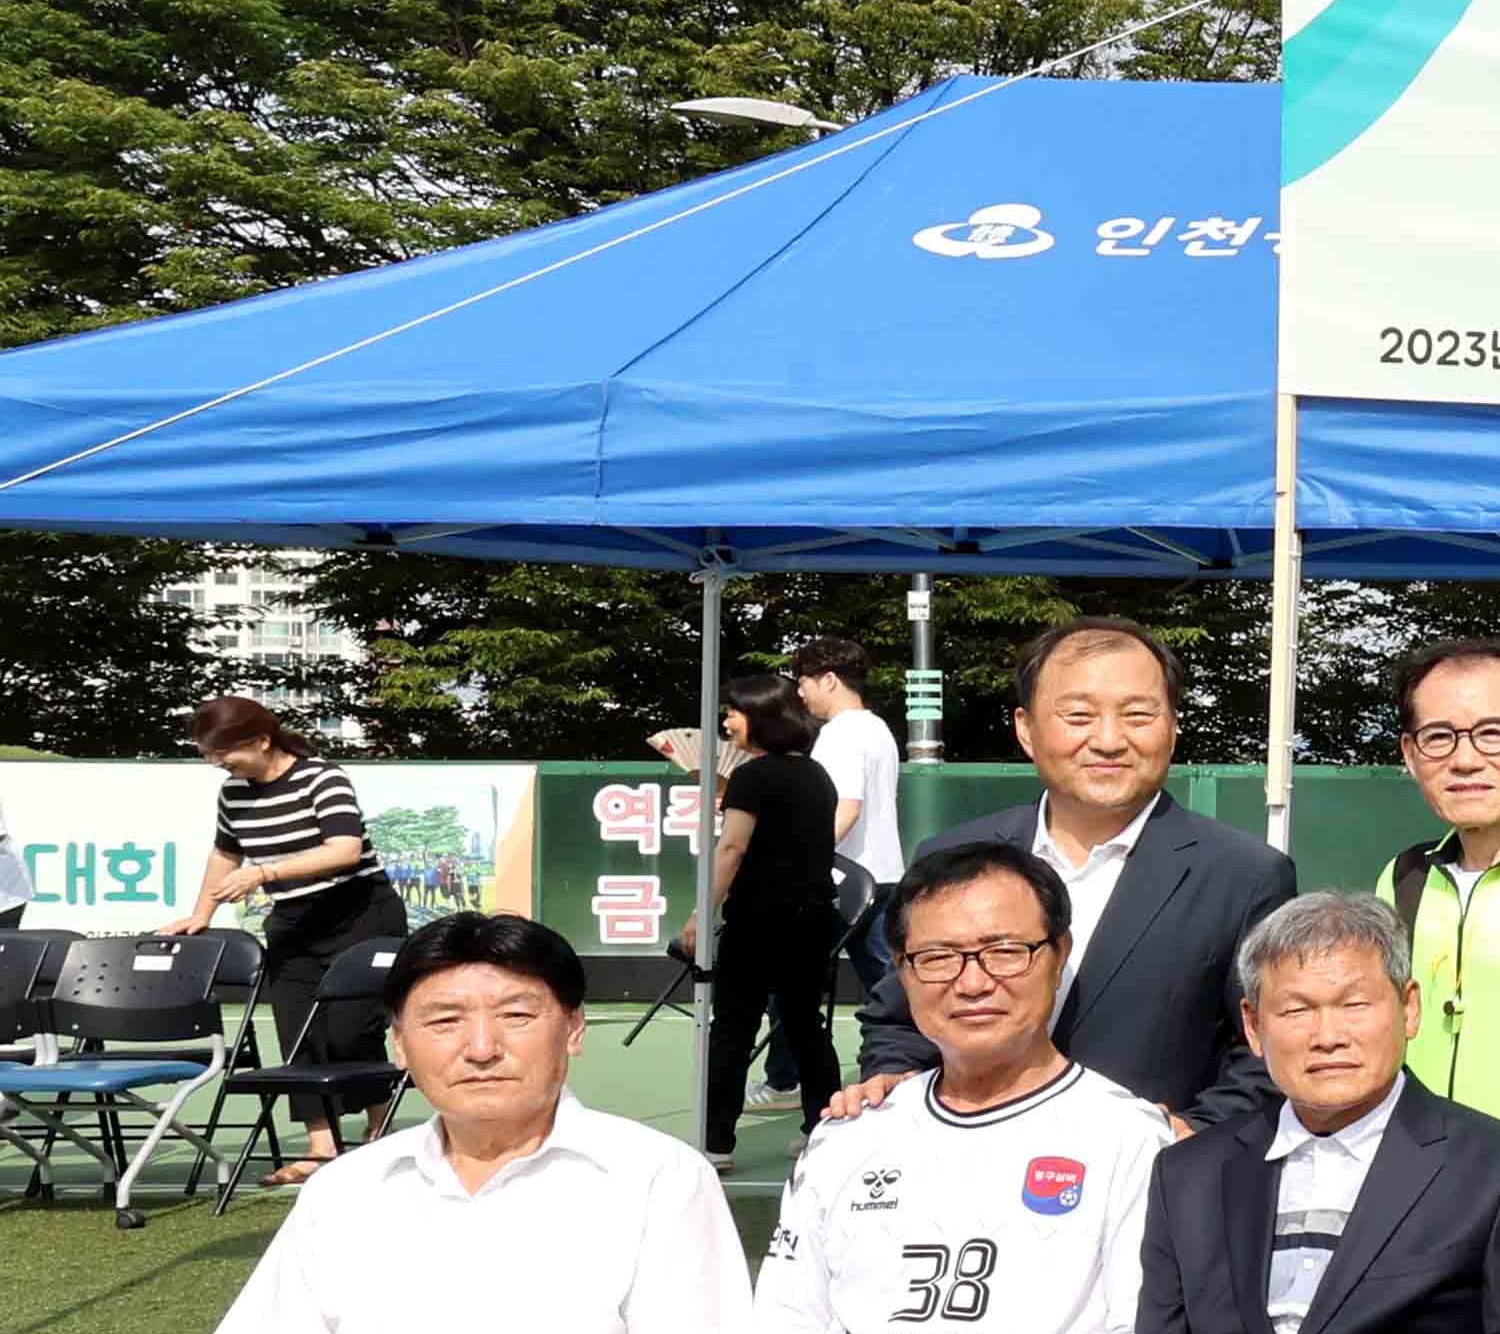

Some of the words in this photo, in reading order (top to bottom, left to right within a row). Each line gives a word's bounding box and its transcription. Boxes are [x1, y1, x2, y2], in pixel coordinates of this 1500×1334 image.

[23, 841, 177, 907] 대회
[592, 875, 667, 944] 금
[850, 1198, 899, 1213] hummel
[888, 1237, 999, 1324] 38
